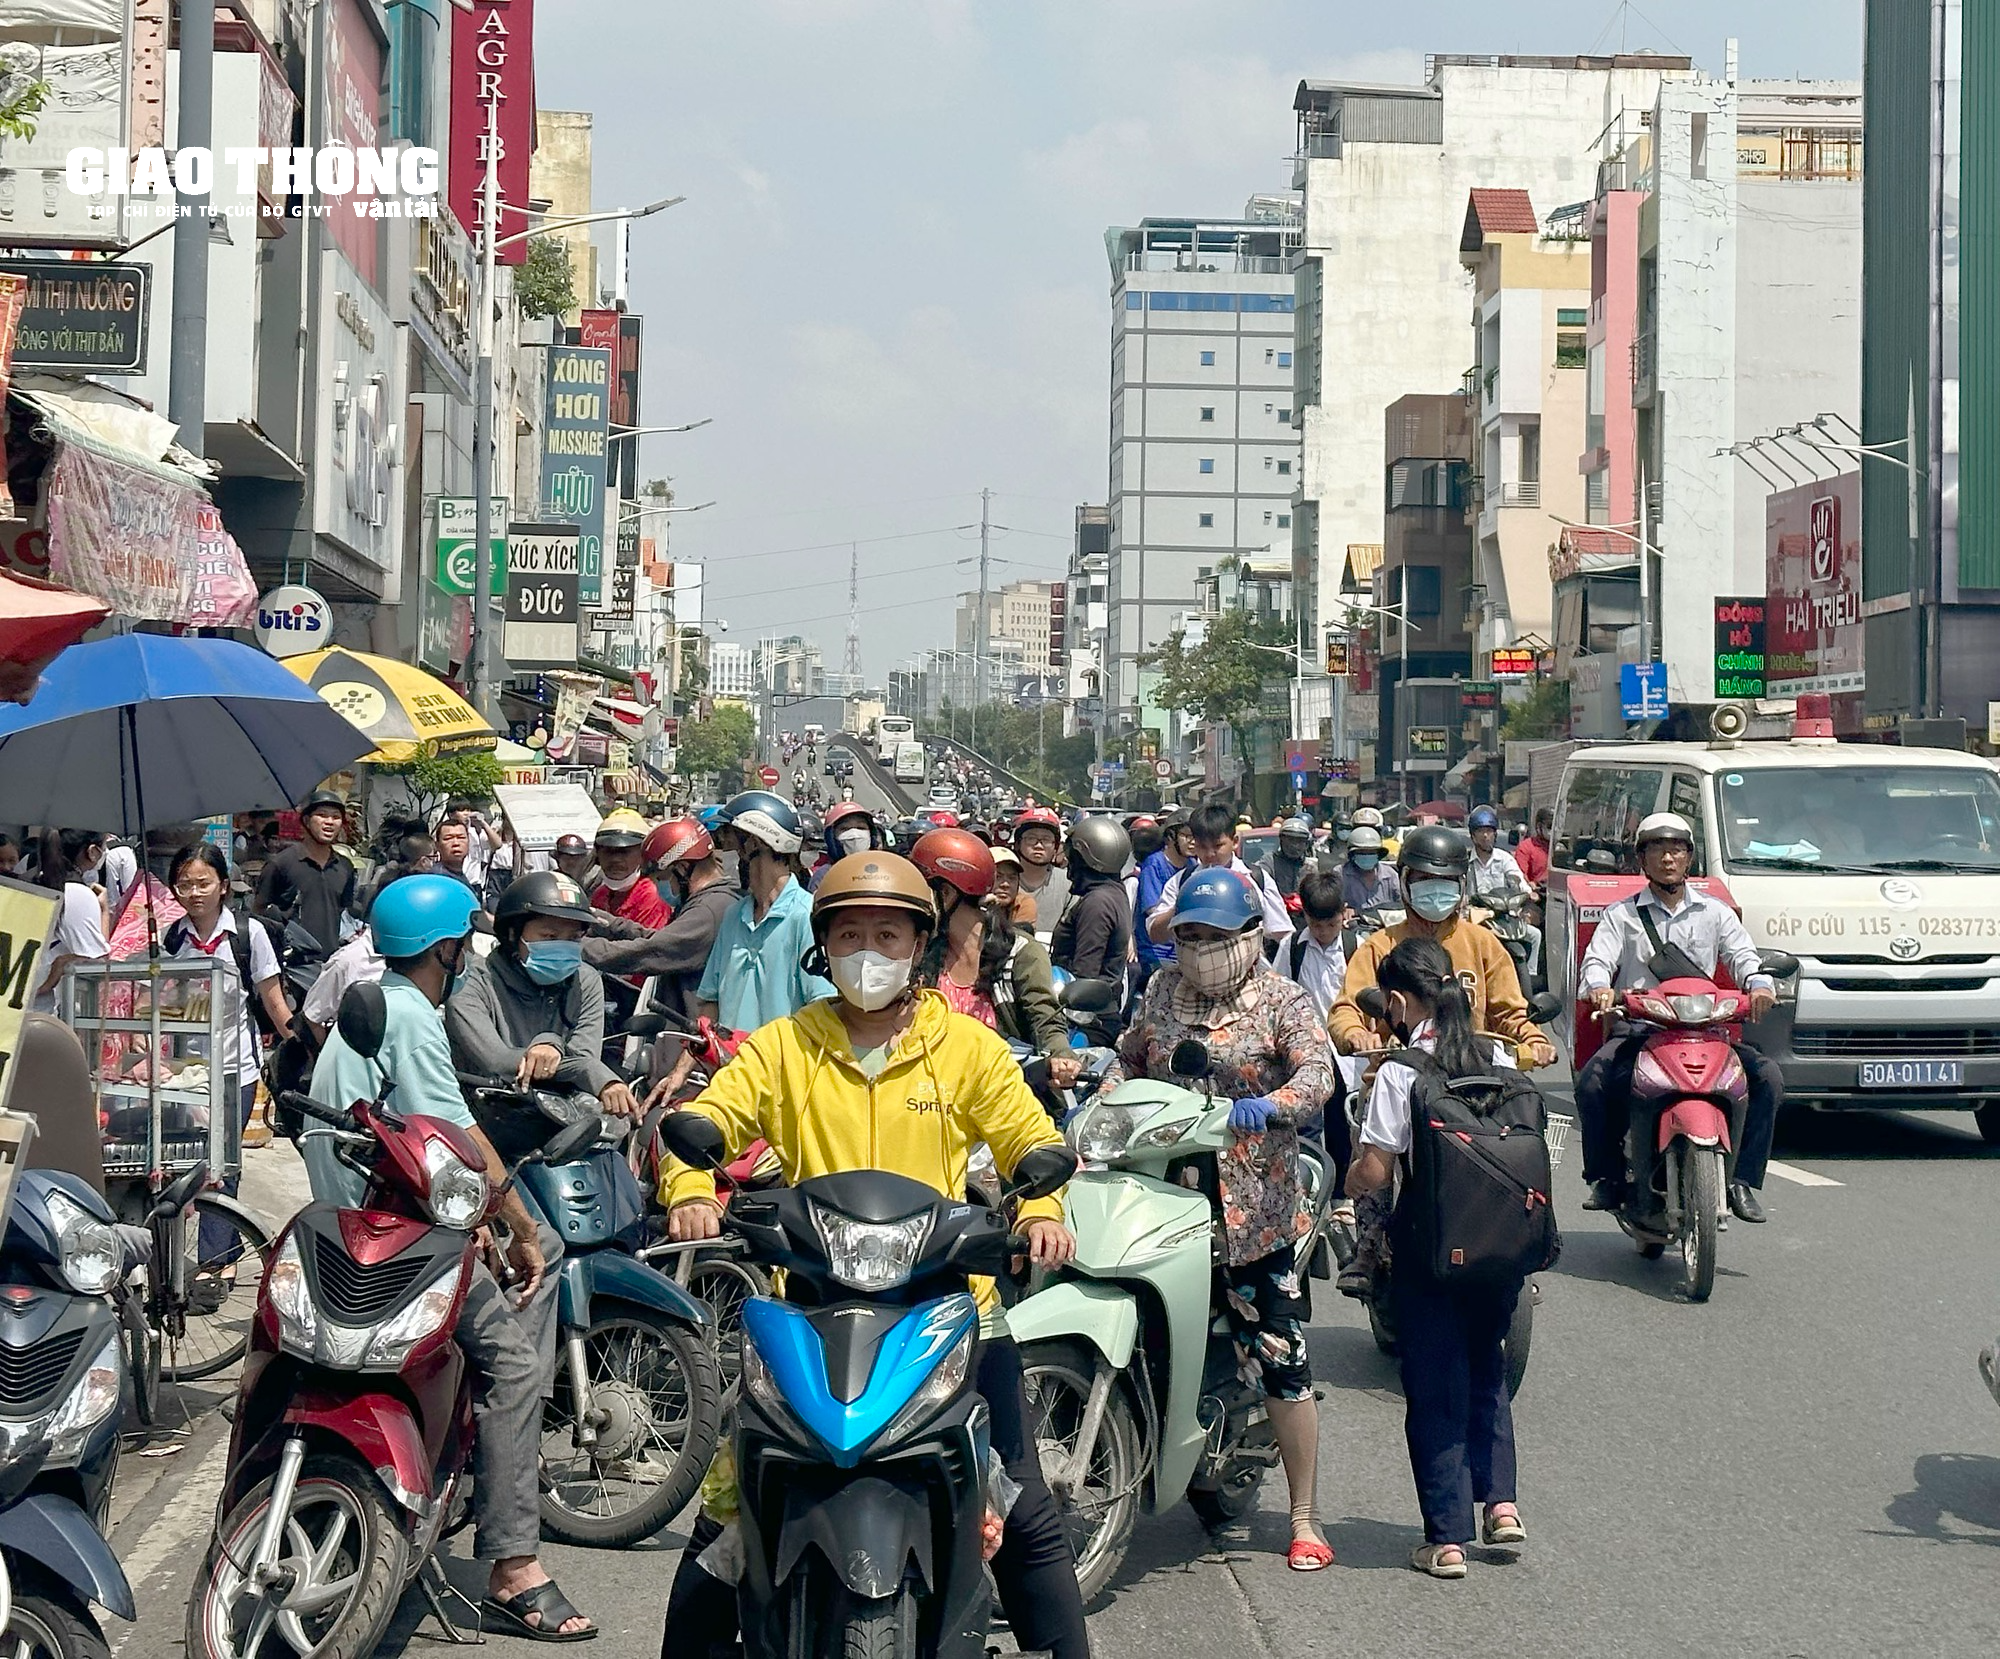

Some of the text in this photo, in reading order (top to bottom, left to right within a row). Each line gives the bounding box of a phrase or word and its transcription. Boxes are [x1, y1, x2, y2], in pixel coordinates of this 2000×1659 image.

[472, 8, 509, 256] AGRIBANK
[44, 279, 72, 316] THỊT
[75, 274, 135, 311] NƯỚNG
[51, 326, 72, 352] VỚI
[75, 331, 97, 356] THỊT
[553, 353, 605, 385] XÔNG
[555, 392, 600, 420] HƠI
[549, 429, 603, 456] MASSAGE
[550, 465, 594, 516] HỮU
[509, 538, 538, 570] XÚC
[545, 540, 578, 570] XÍCH
[520, 583, 564, 615] ĐỨC
[1785, 587, 1810, 634] HẢI
[1718, 650, 1764, 671] CHÍNH
[1766, 907, 1802, 936] CẤP
[1808, 912, 1845, 936] CỨU
[1858, 917, 1891, 936] 115
[1918, 917, 2000, 937] 0283773
[1863, 1063, 1957, 1082] 50A-011.41
[833, 1308, 876, 1318] HONDA
